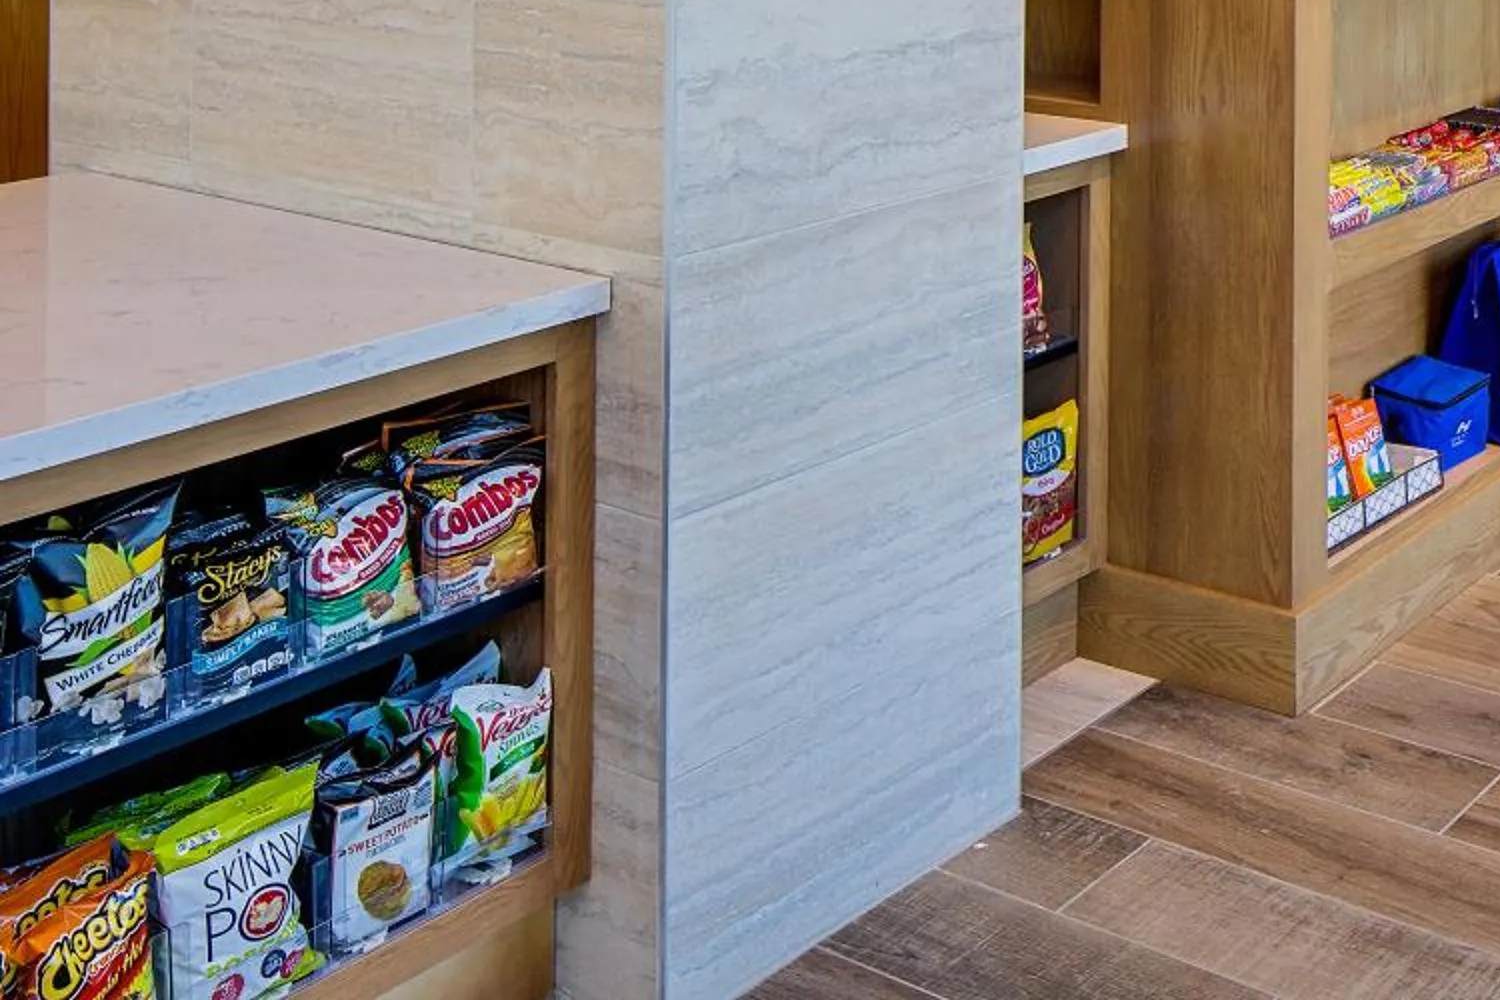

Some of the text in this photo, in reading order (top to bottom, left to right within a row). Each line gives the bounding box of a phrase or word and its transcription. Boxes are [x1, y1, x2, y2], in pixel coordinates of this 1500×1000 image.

[310, 493, 406, 584] Combos
[428, 470, 539, 541] Combos
[55, 660, 104, 692] WHITE
[203, 824, 302, 909] SKINNY
